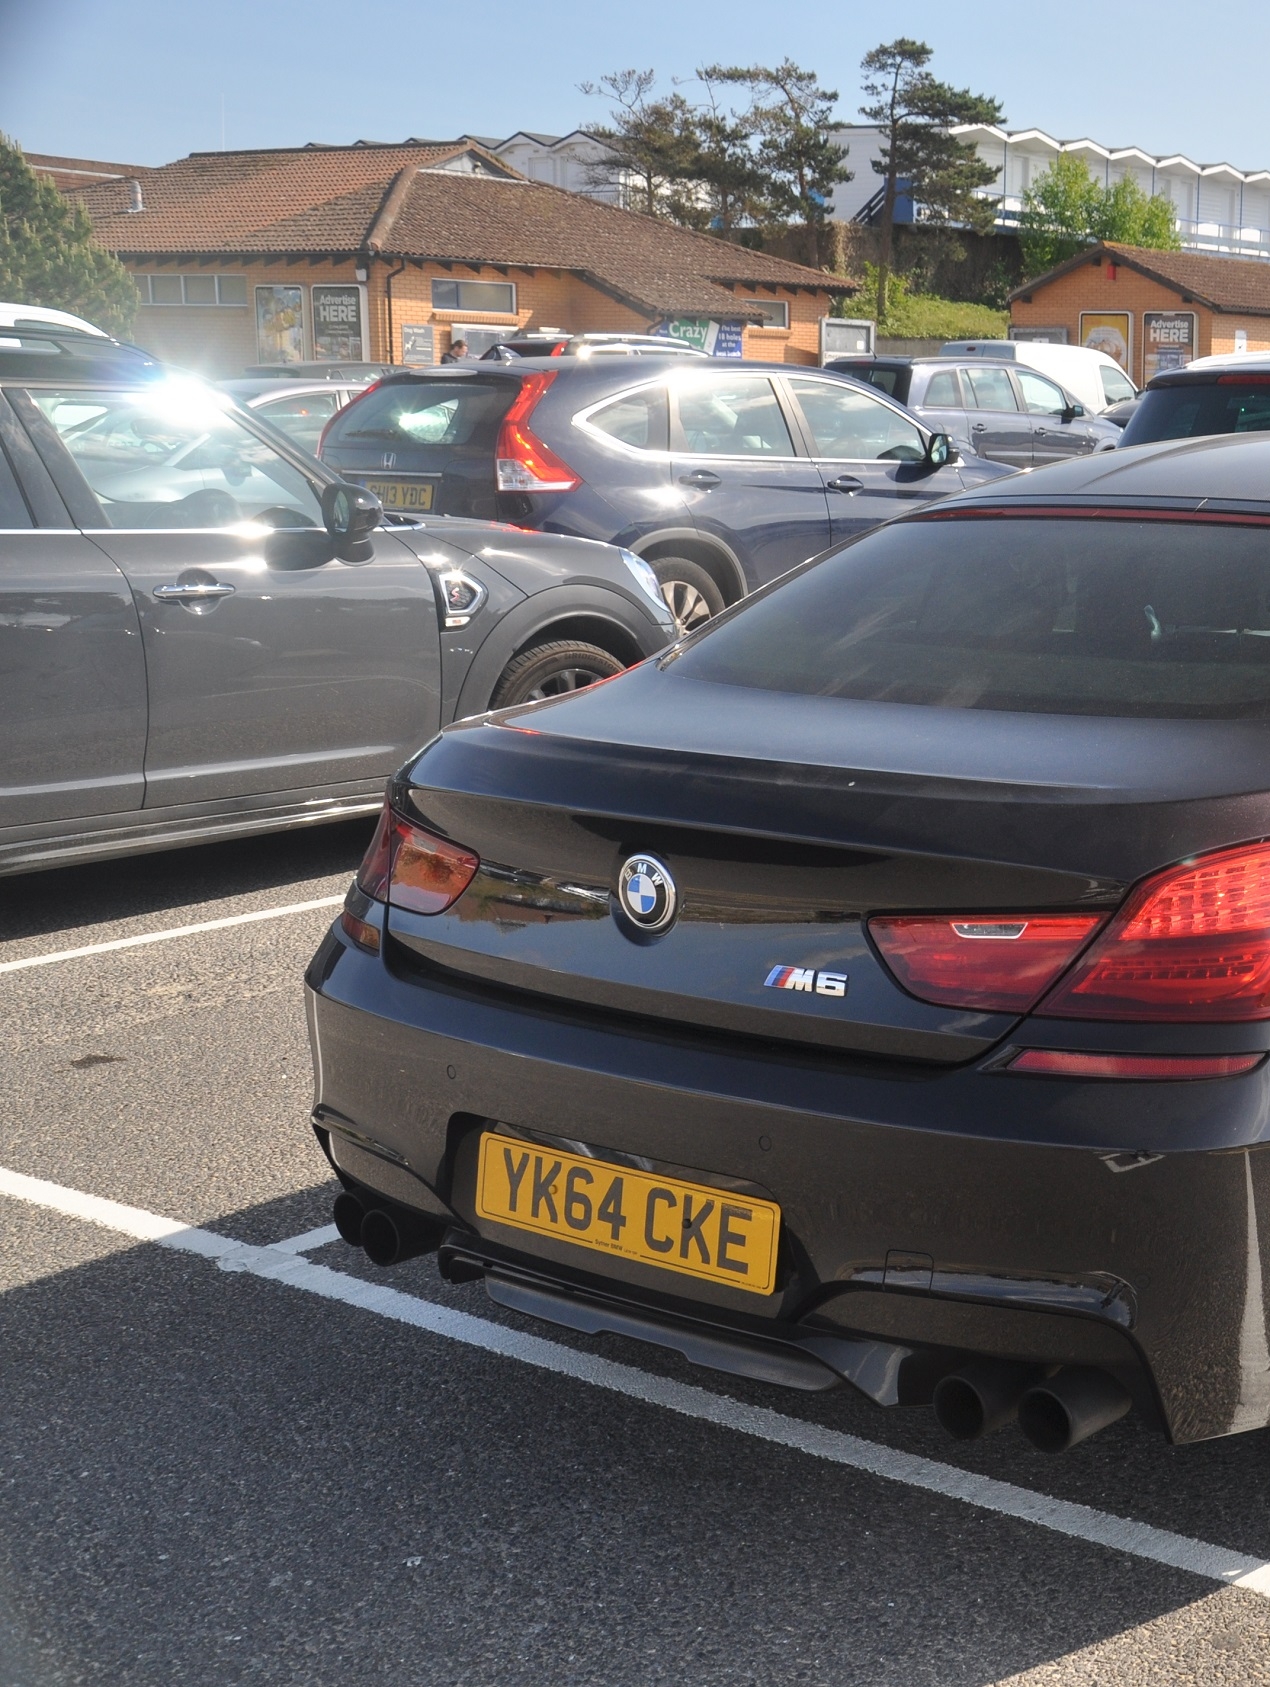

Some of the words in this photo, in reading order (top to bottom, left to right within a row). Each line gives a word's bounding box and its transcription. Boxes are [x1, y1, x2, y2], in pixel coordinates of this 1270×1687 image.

[320, 294, 356, 305] Advertise
[320, 305, 357, 322] HERE
[669, 320, 708, 342] Crazy
[1150, 319, 1189, 328] Advertise
[726, 332, 741, 340] holes
[1150, 329, 1189, 342] HERE
[401, 486, 427, 506] YDC
[624, 862, 664, 886] BMW
[785, 967, 848, 997] M6
[503, 1147, 627, 1242] YK64
[644, 1186, 754, 1276] CKE
